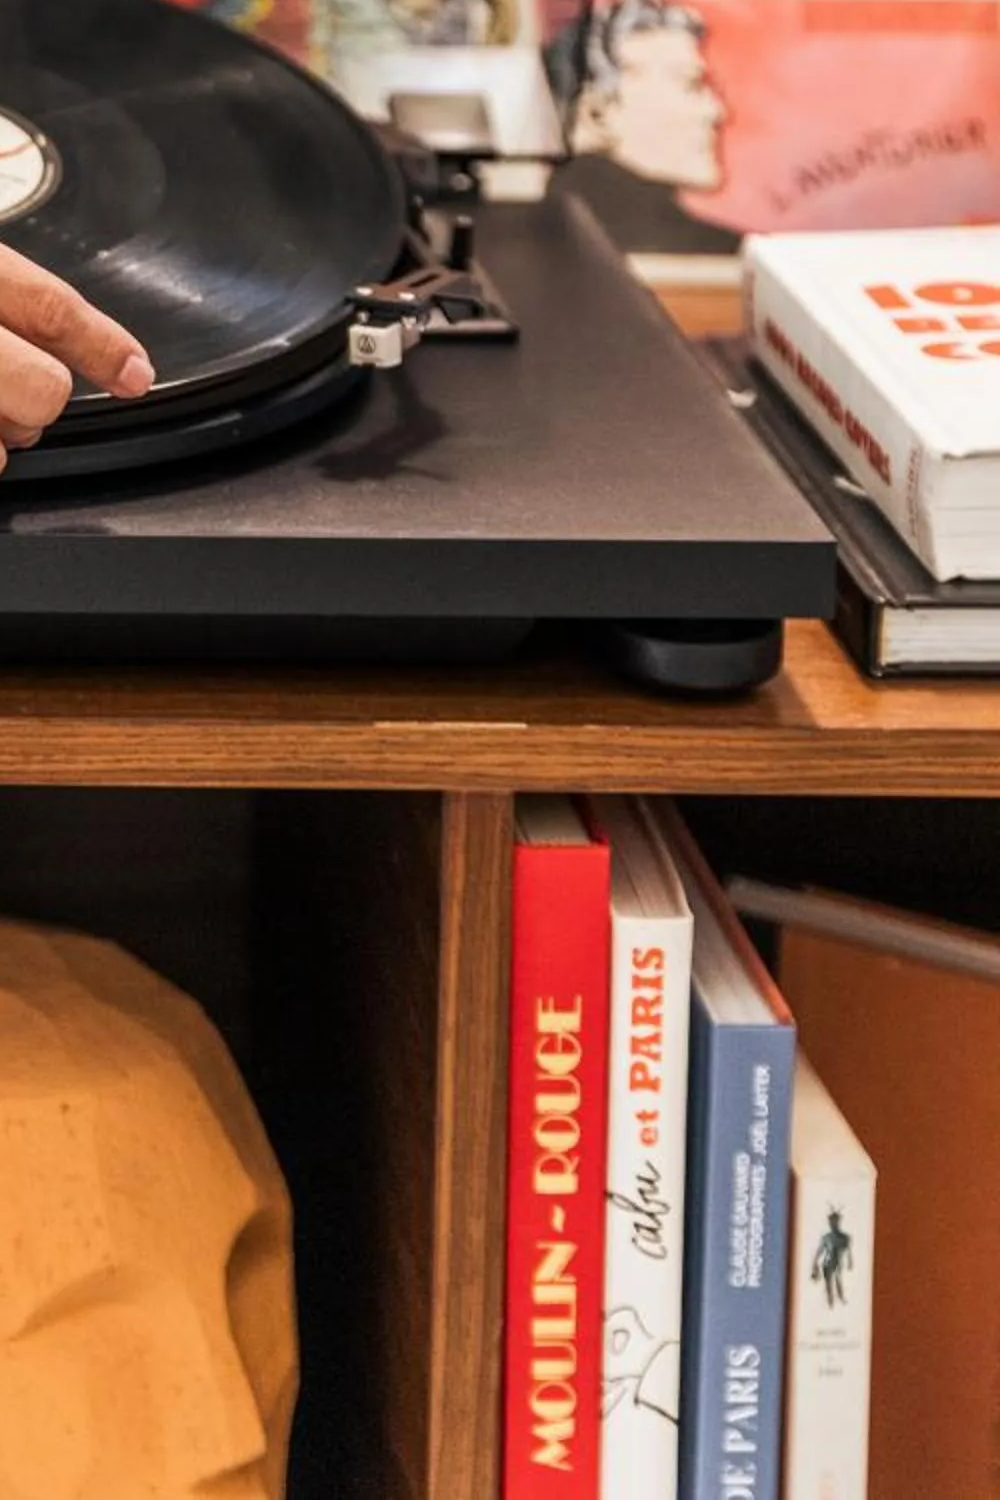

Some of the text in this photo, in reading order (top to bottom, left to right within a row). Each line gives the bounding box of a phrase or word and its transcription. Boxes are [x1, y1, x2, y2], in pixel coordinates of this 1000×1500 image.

[629, 946, 666, 1094] PARIS
[636, 1108, 660, 1148] et
[722, 1344, 762, 1453] PARIS
